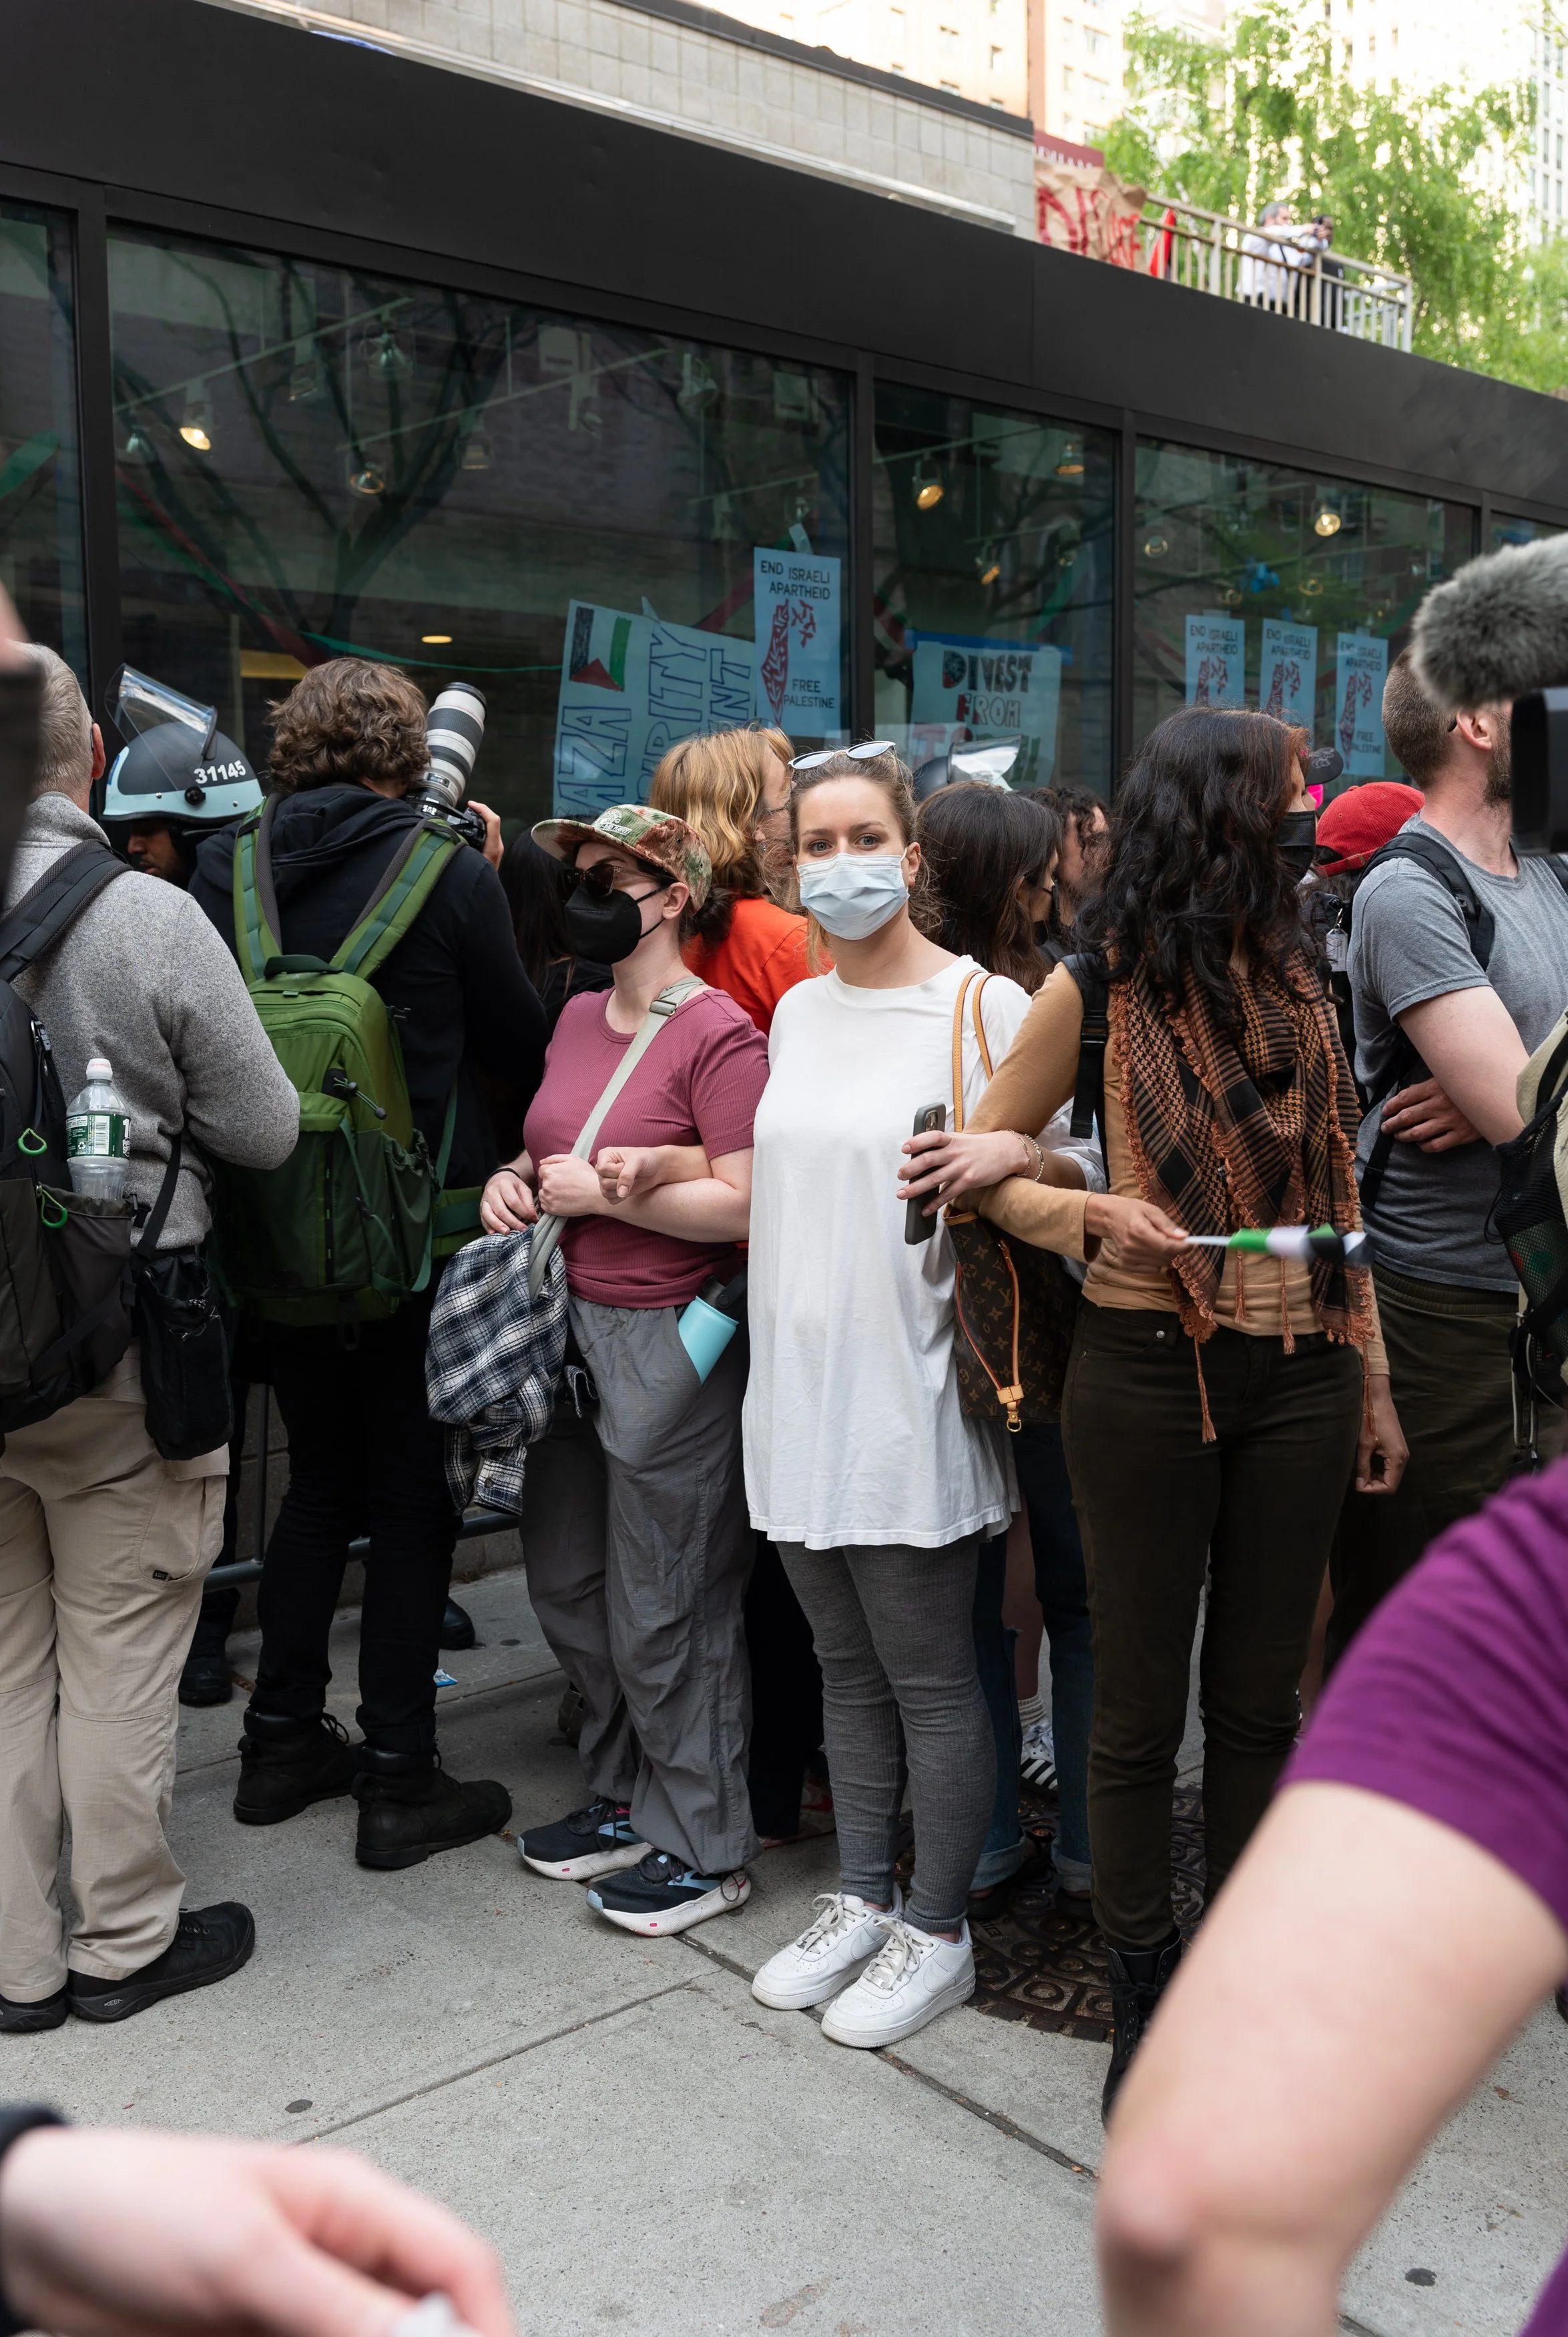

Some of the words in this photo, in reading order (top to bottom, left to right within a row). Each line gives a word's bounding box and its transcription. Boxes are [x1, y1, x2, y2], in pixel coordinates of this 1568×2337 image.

[761, 560, 783, 575] END
[788, 566, 830, 584] ISRAELI
[769, 581, 830, 600] APARTHEID
[1190, 625, 1206, 636] END
[1209, 629, 1238, 642] ISRAELI
[1266, 628, 1281, 640] END
[1284, 634, 1311, 648] ISRAELI
[1196, 642, 1238, 655] APARTHEID
[1271, 645, 1310, 660] APARTHEID
[1341, 641, 1355, 652] END
[1357, 646, 1382, 659] ISRAELI
[943, 650, 1033, 693] DIVEST
[1345, 657, 1382, 671] APARTHEID
[792, 678, 821, 693] FREE
[784, 694, 835, 708] PALESTINE
[956, 692, 1021, 728] FROM
[557, 706, 631, 816] AZA
[194, 760, 246, 784] 31145
